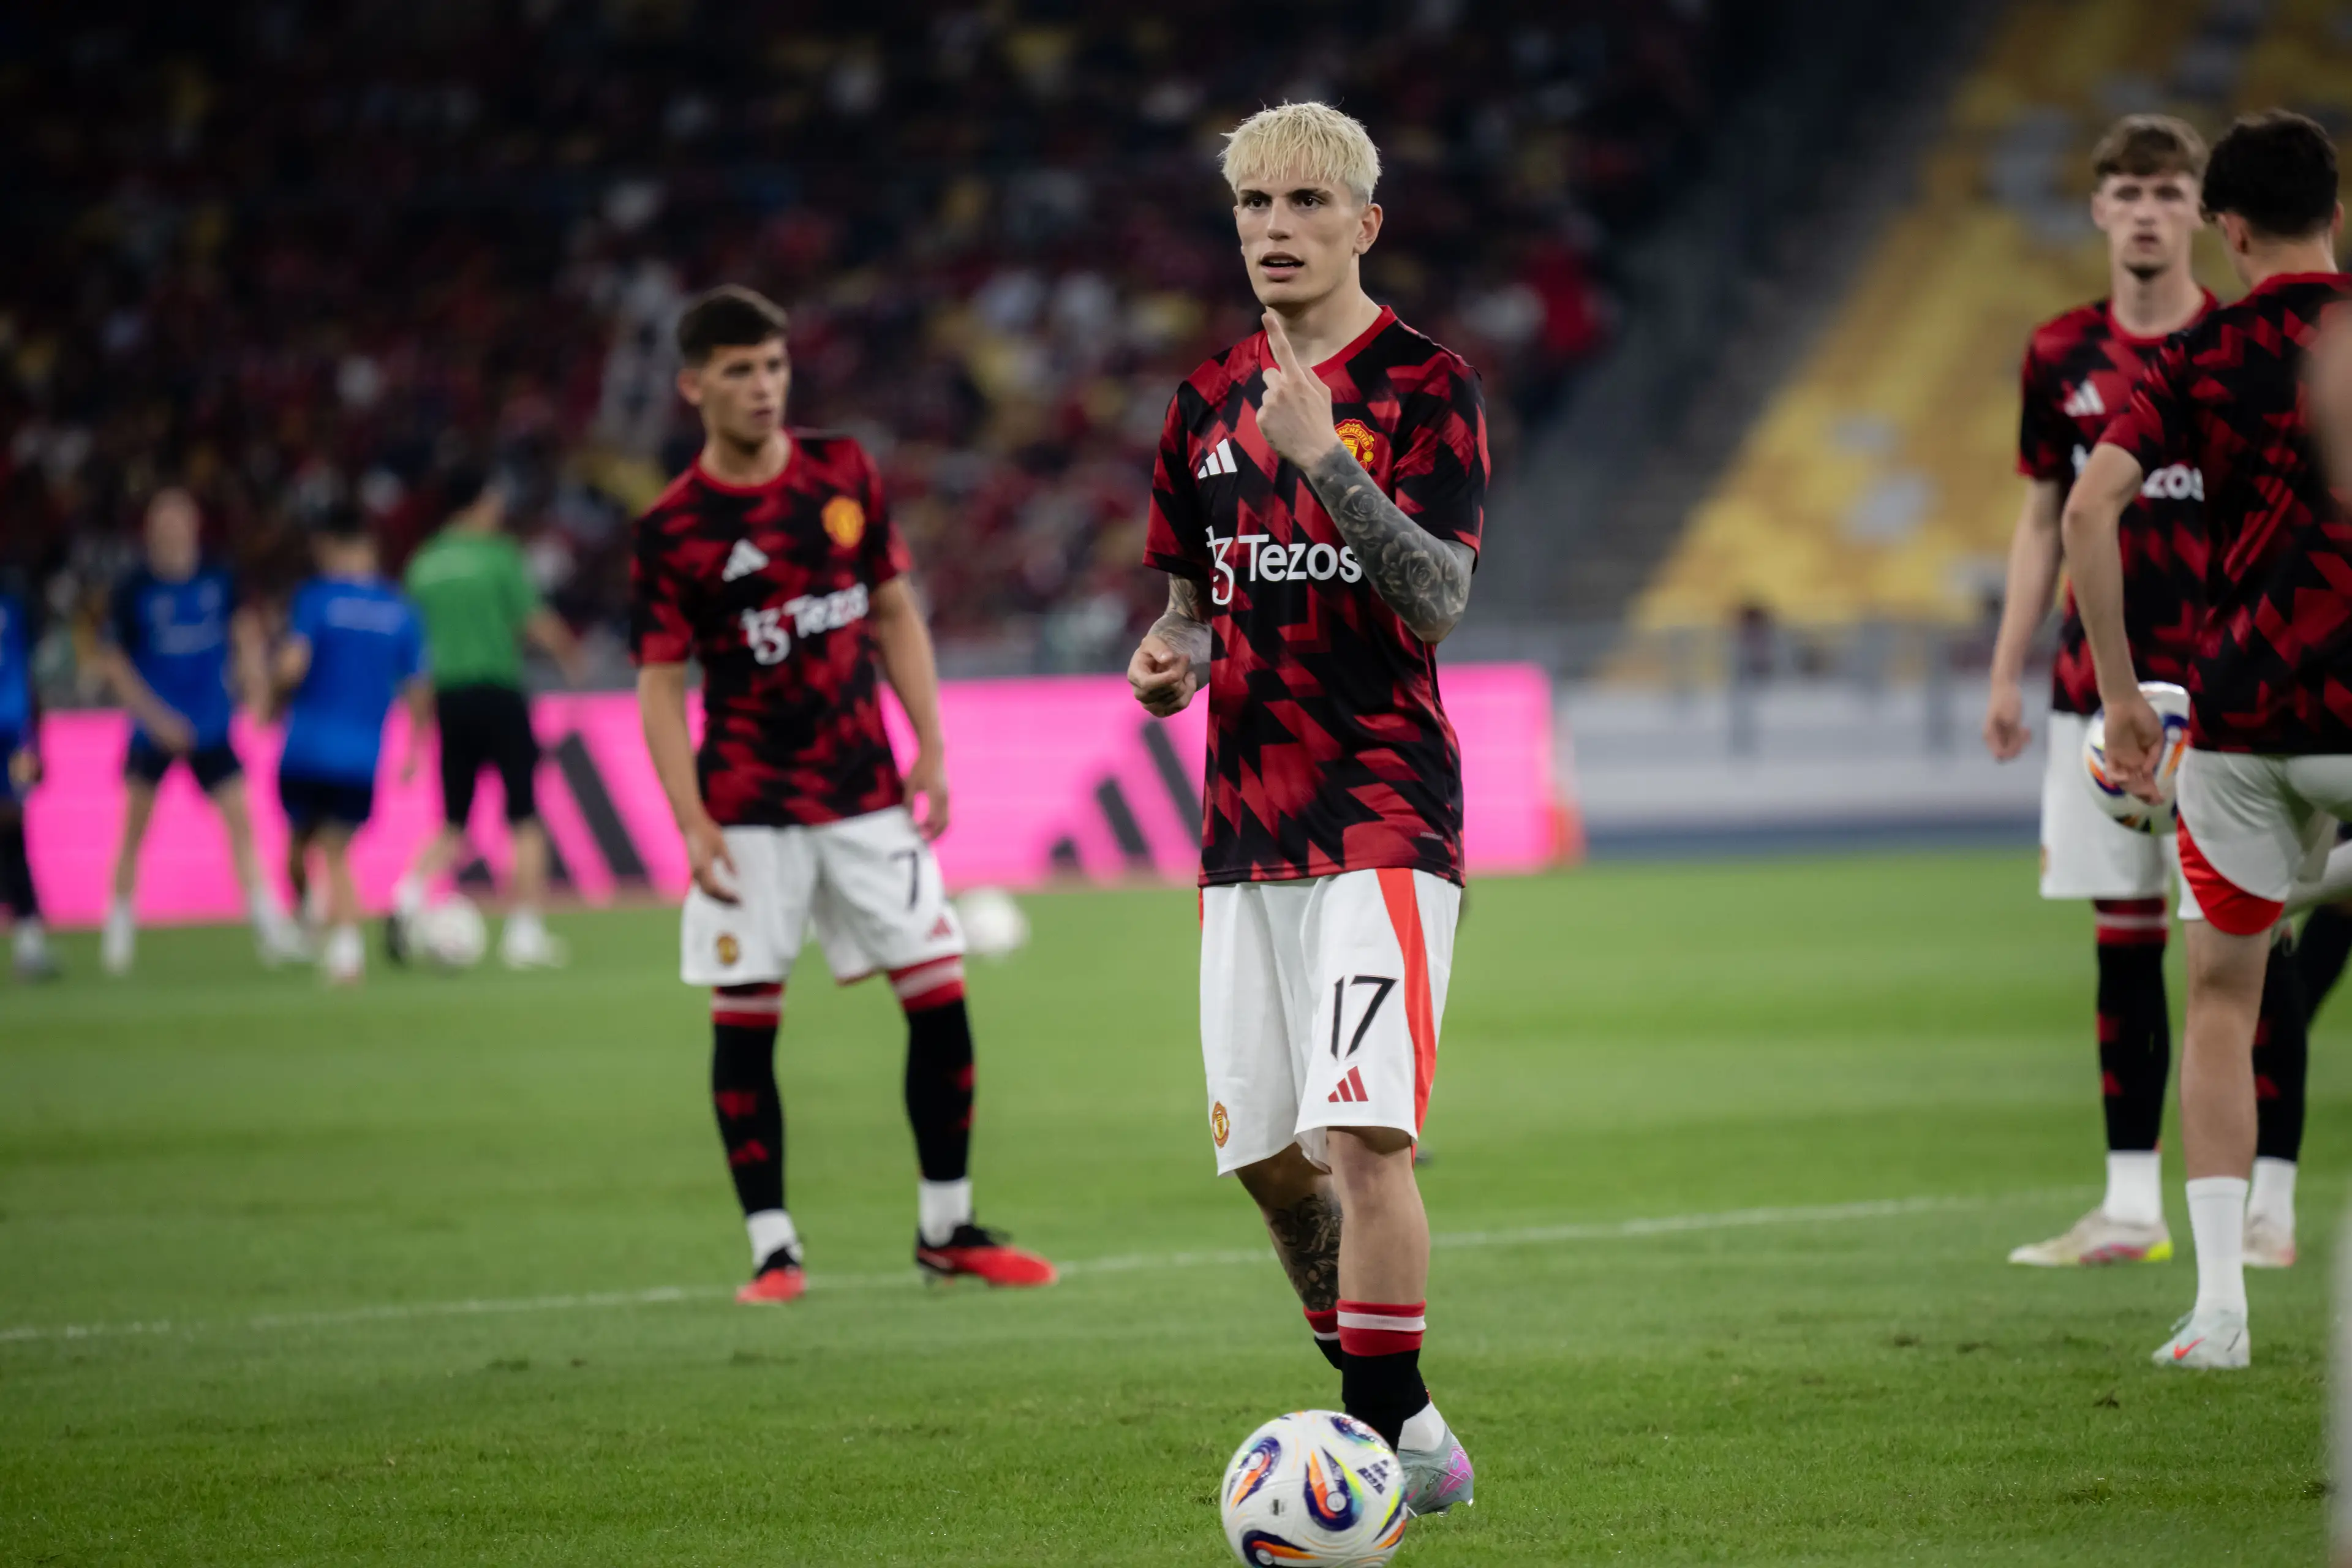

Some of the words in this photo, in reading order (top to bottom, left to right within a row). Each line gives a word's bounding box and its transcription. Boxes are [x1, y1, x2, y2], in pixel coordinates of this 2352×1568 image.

[1336, 427, 1371, 447] NCHESTER
[1238, 534, 1362, 583] Tezos
[889, 848, 919, 911] 7
[1330, 974, 1400, 1061] 17
